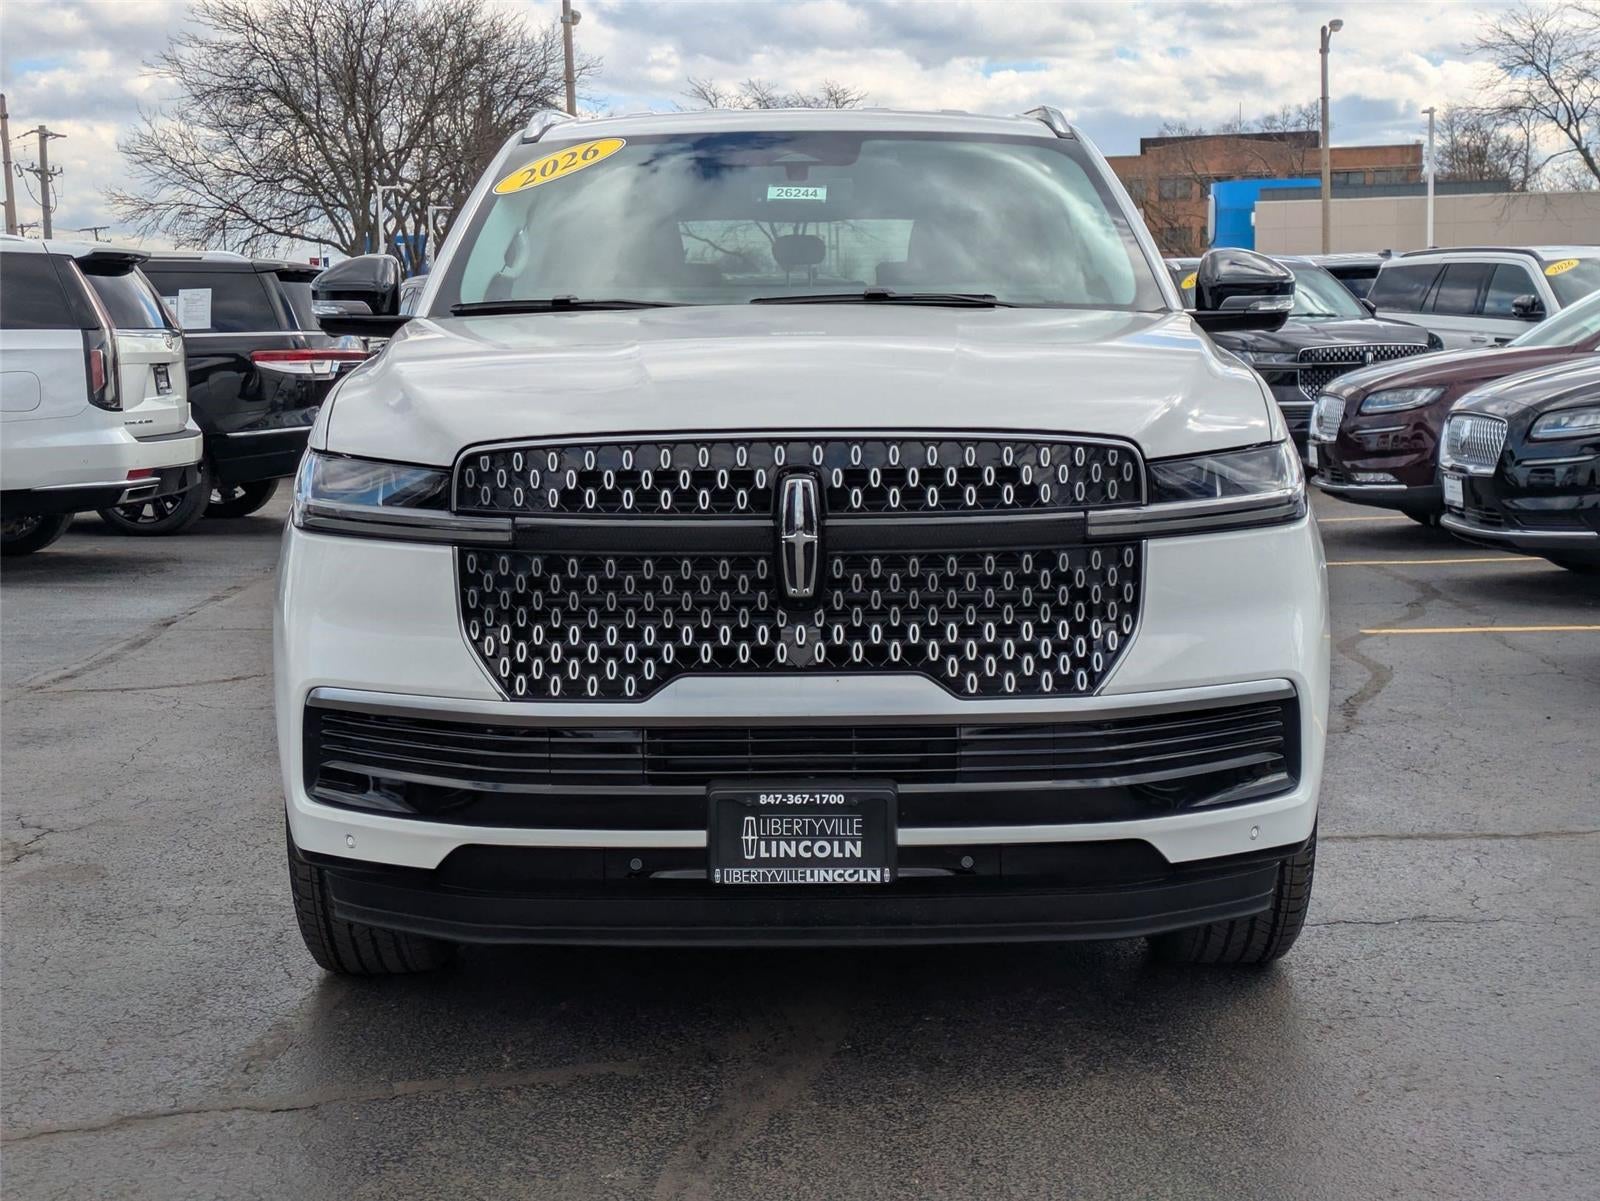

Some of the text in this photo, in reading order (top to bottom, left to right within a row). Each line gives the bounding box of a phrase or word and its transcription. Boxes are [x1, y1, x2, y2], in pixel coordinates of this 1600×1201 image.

[519, 142, 600, 187] 2026
[776, 188, 818, 199] 26244
[759, 794, 845, 805] 847-367-1700
[760, 818, 863, 836] LIBERTYVILLE
[760, 840, 862, 858] LINCOLN
